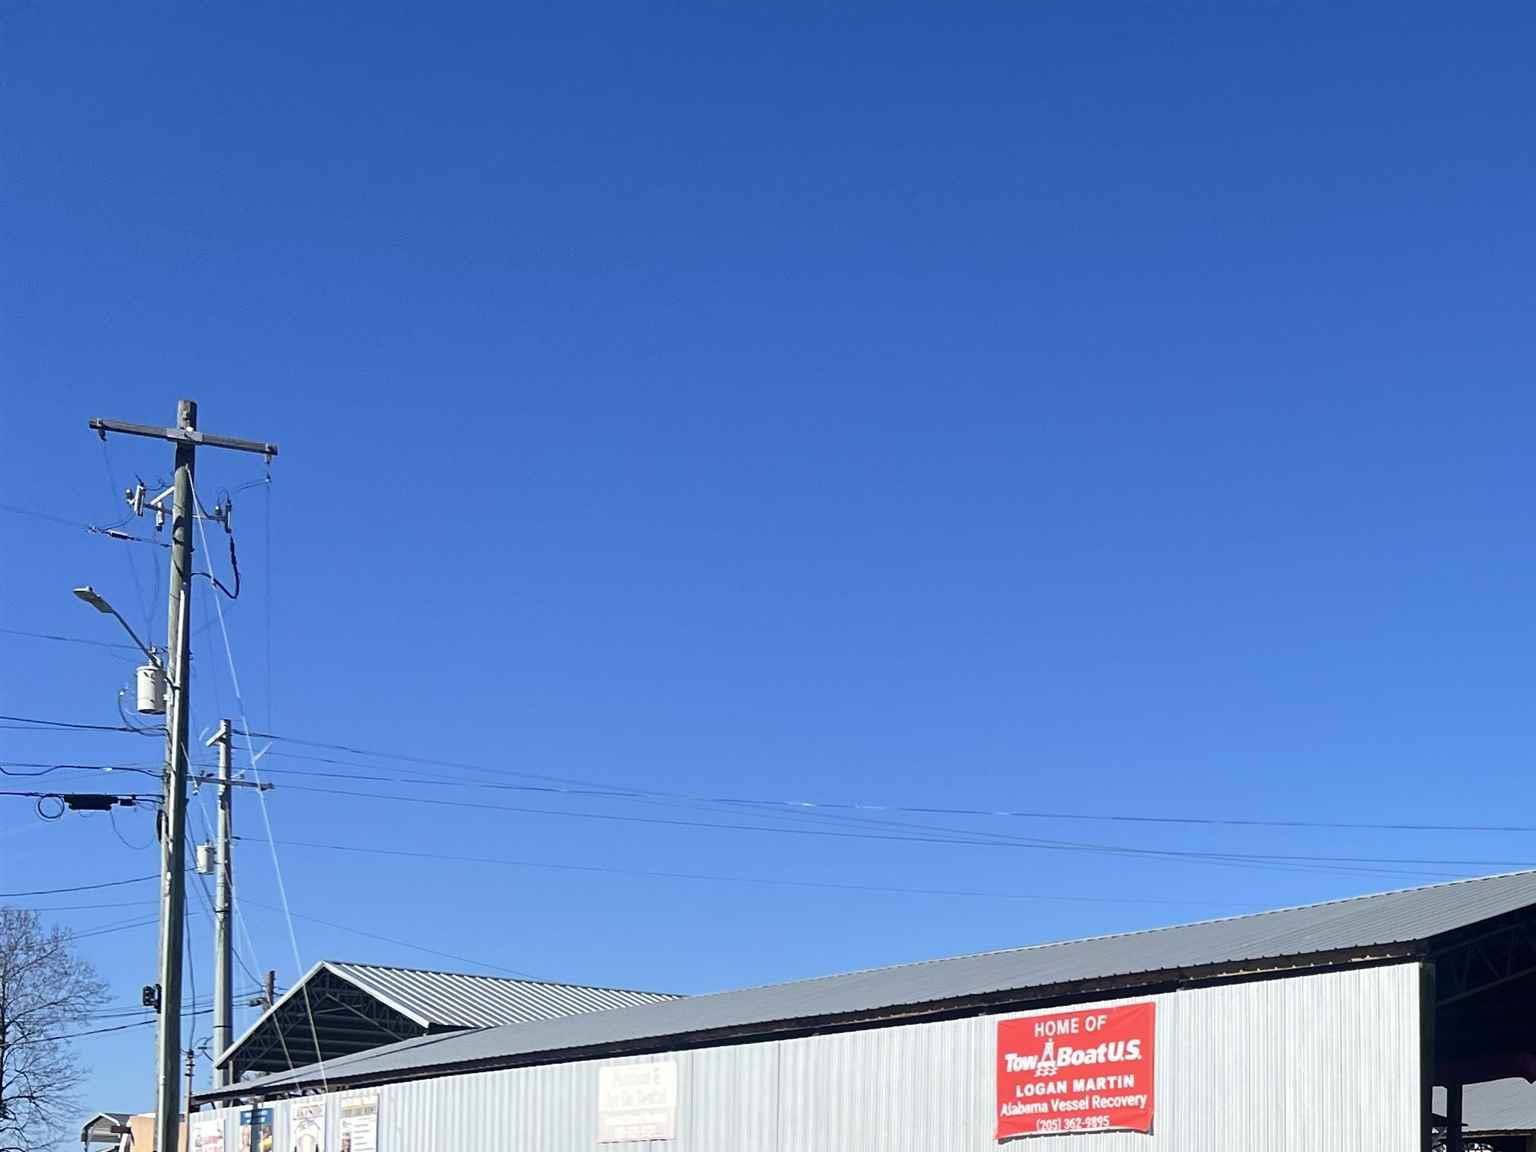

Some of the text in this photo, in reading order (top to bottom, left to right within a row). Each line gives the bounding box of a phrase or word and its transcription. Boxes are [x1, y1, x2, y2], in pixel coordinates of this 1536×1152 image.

[1034, 1015, 1107, 1037] HOME OF
[1005, 1052, 1037, 1072] Tow
[1016, 1074, 1135, 1097] LOGAN MARTIN
[1001, 1094, 1148, 1116] Alabama Vessel Recovery
